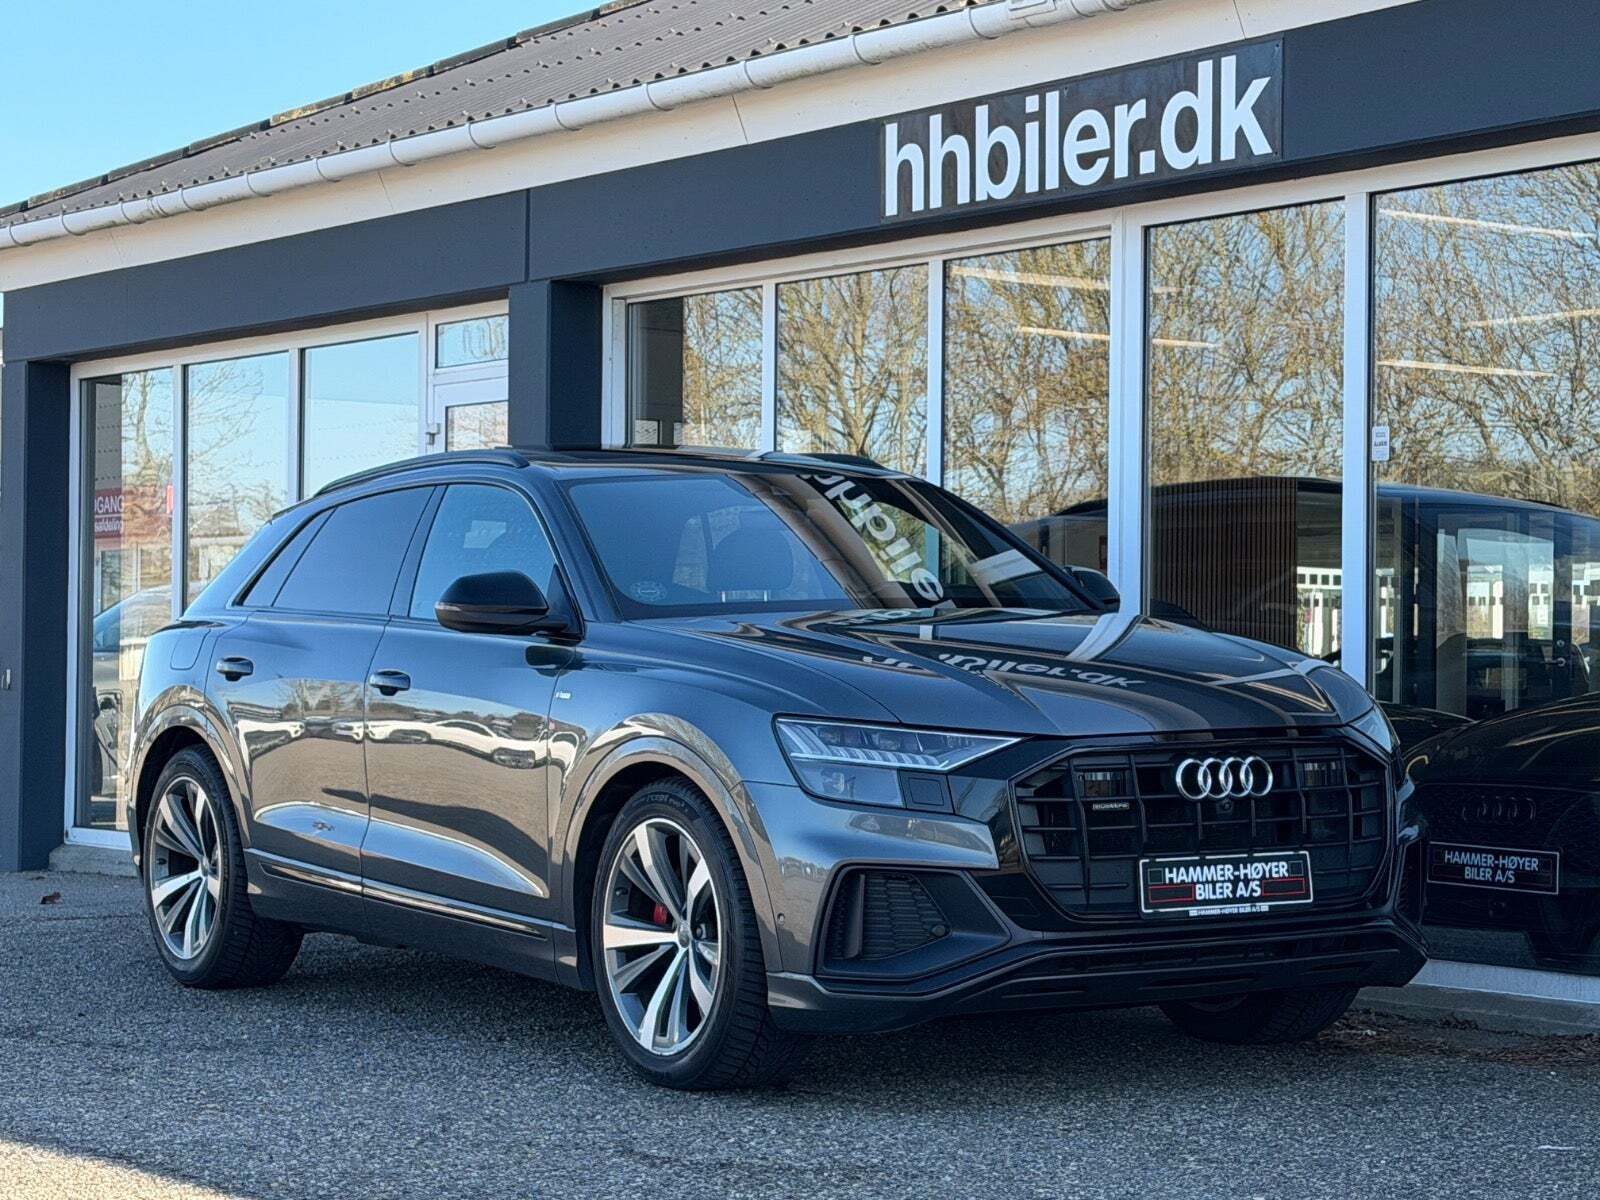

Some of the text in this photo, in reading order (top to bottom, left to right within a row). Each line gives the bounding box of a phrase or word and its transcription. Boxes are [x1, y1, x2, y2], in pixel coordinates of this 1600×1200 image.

[884, 54, 1273, 217] hhbiler.dk
[95, 495, 124, 513] GANG
[1444, 850, 1539, 871] HAMMER-HØYER
[1164, 861, 1289, 884] HAMMER-HØYER
[1464, 866, 1516, 883] BILER A/S
[1195, 879, 1262, 900] BILER A/S
